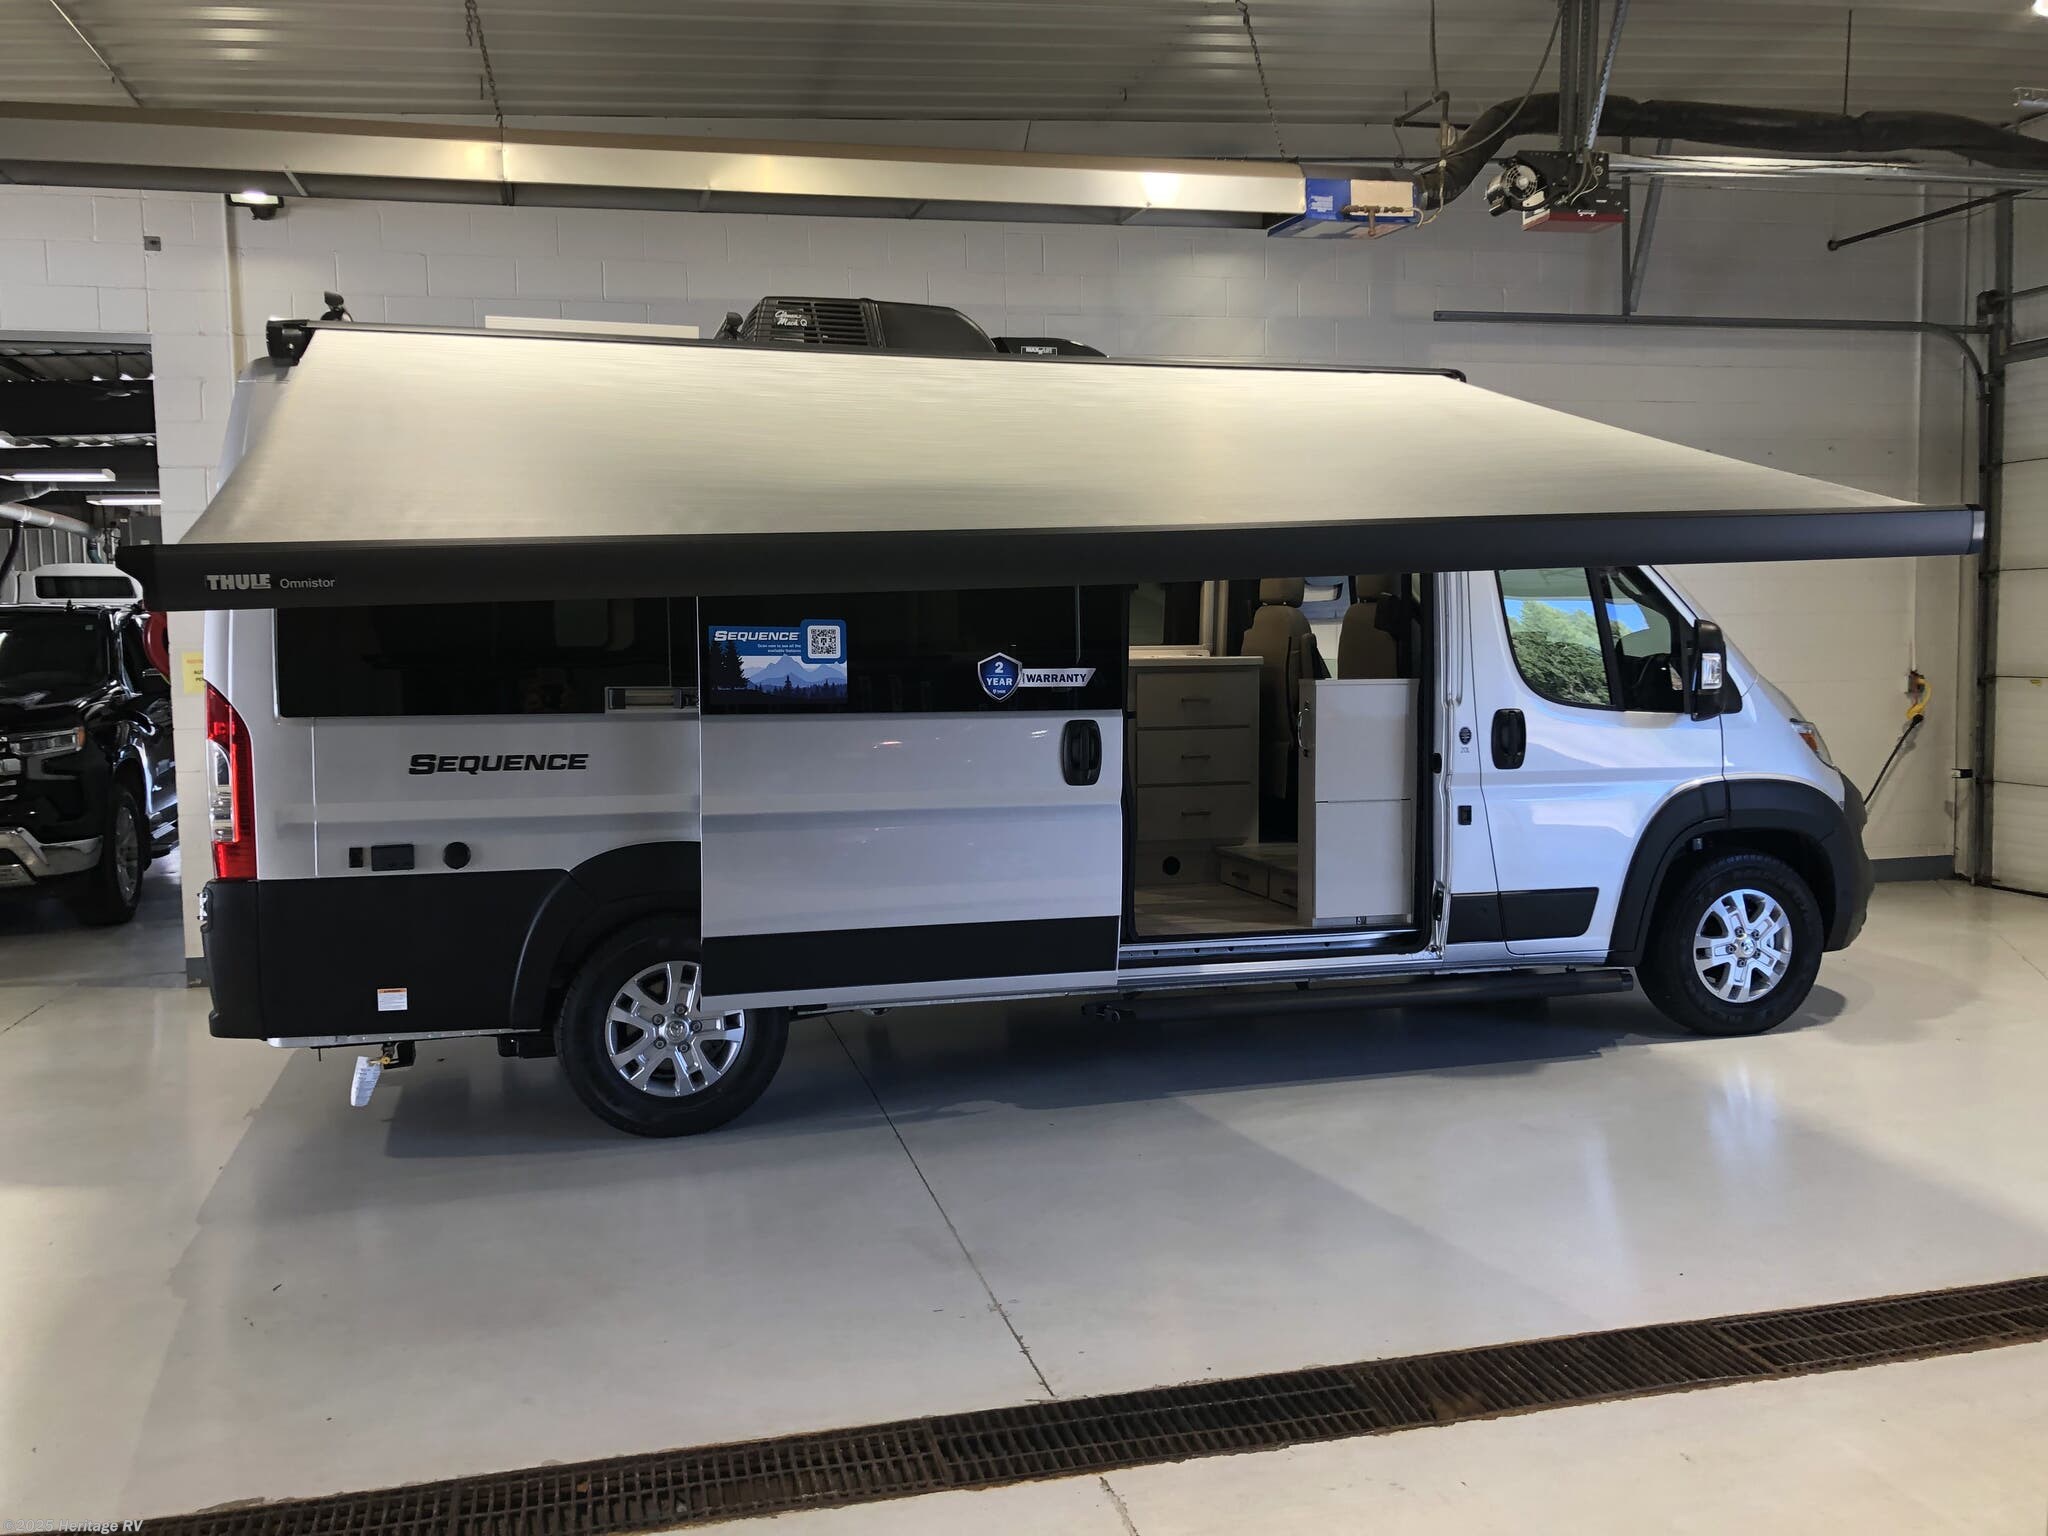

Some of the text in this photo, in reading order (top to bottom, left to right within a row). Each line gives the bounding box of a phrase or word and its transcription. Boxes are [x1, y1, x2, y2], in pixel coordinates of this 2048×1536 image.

[206, 574, 335, 590] THULE Omnistor
[994, 661, 1004, 674] 2
[986, 677, 1013, 686] YEAR
[1026, 673, 1087, 683] WARRANTY
[408, 753, 589, 775] SEQUENCE
